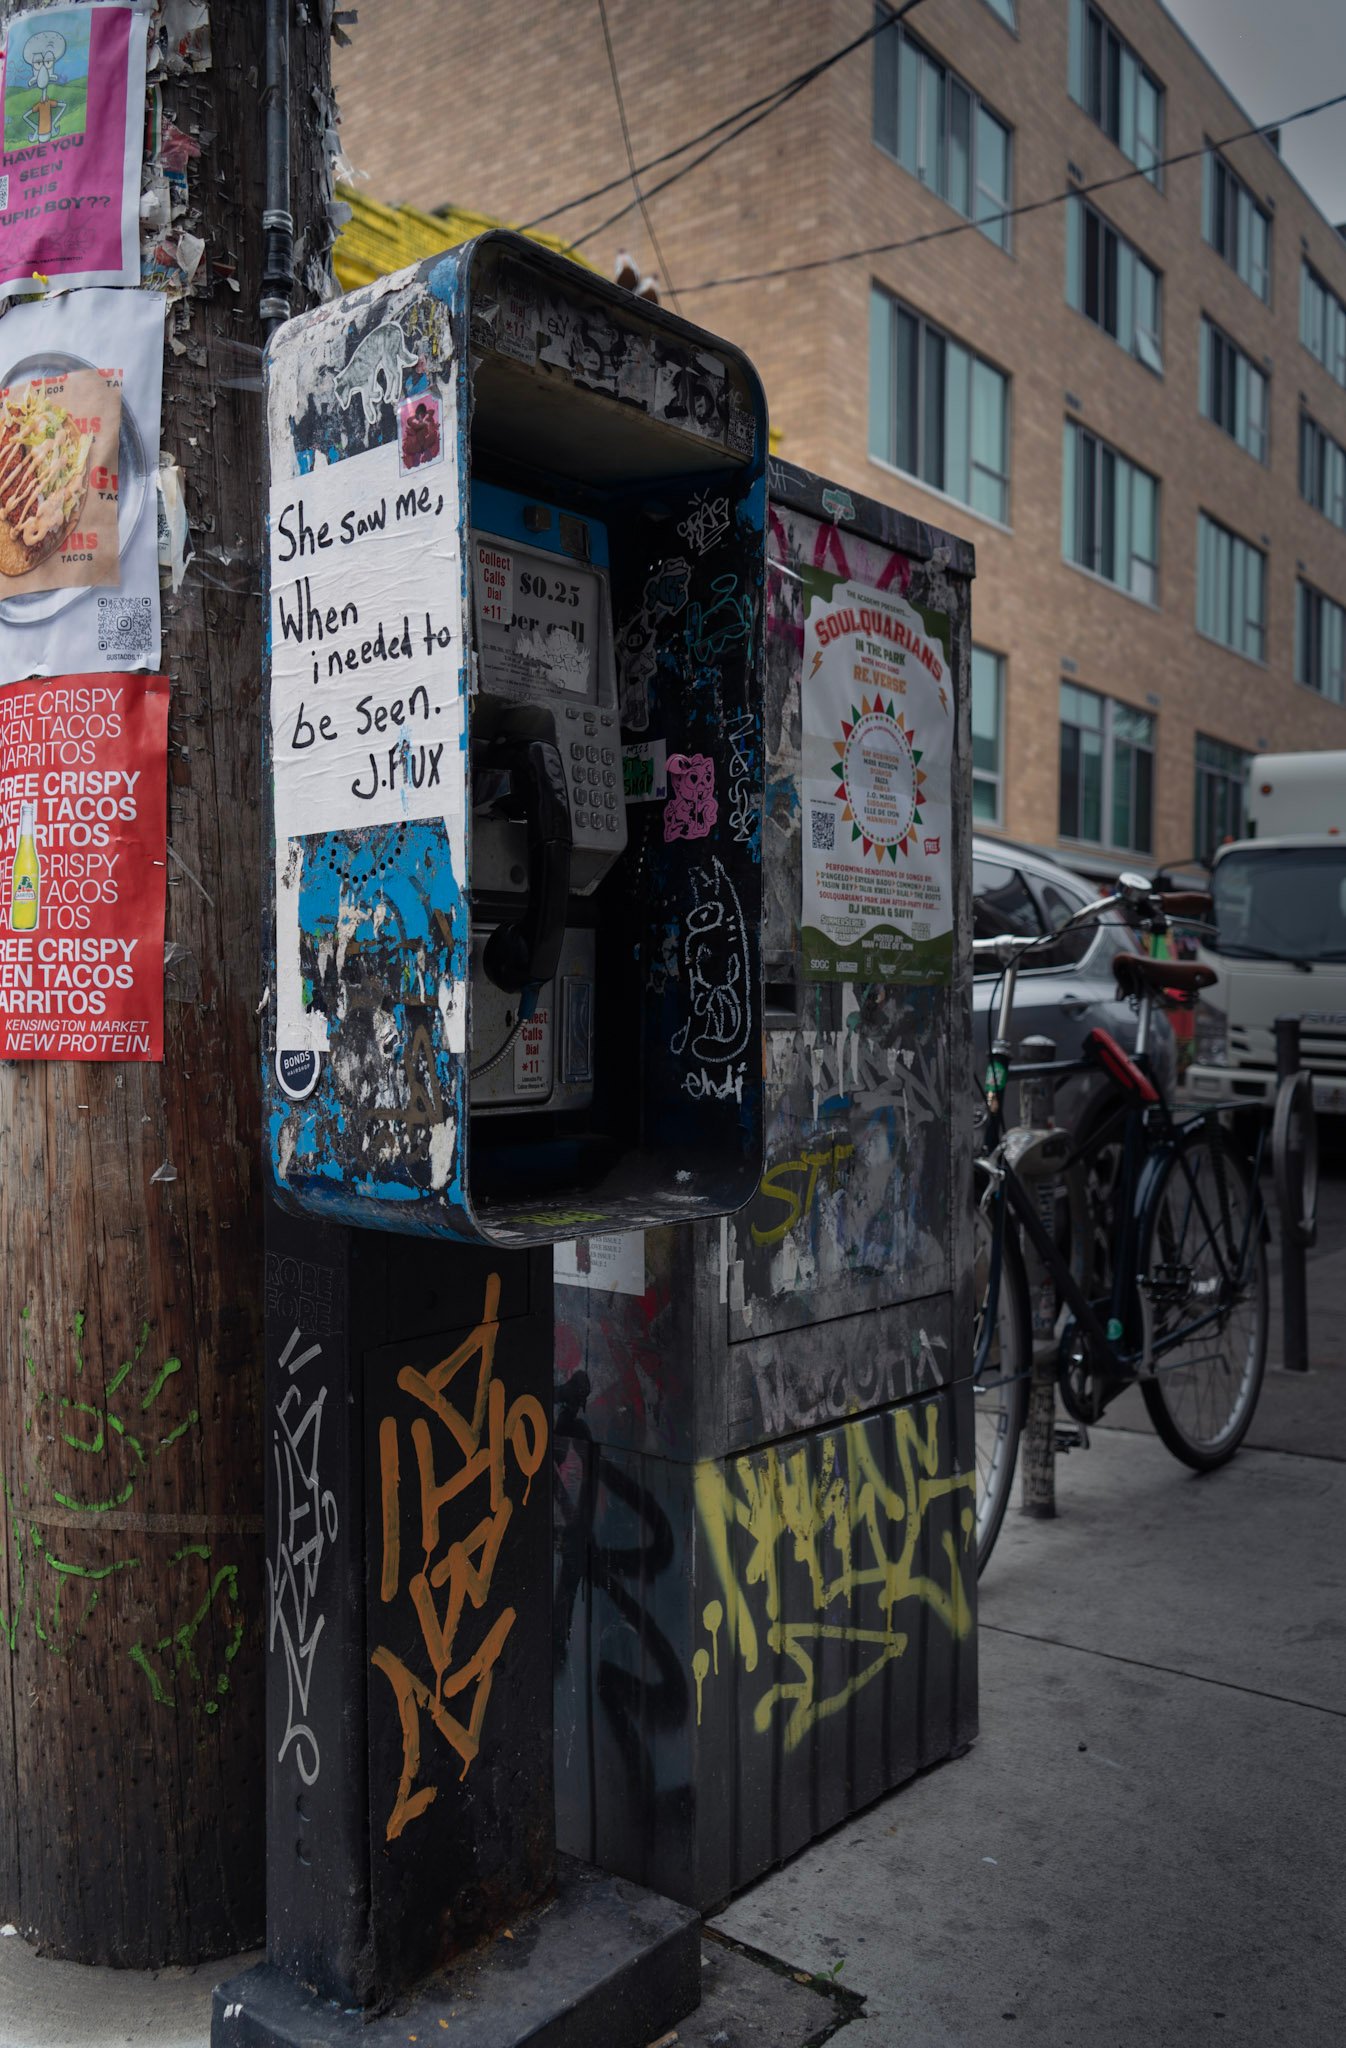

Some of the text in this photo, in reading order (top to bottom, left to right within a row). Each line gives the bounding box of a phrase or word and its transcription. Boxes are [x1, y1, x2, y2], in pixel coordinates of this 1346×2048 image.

[2, 136, 84, 167] HAVE YOU
[20, 160, 63, 182] SEEN
[24, 182, 57, 200] THIS
[0, 196, 111, 226] UPID BOY??
[279, 500, 333, 562] She
[61, 553, 93, 564] TACOS
[479, 549, 512, 571] Collect
[483, 568, 506, 587] Calls
[519, 572, 581, 607] $0.25
[487, 586, 502, 600] Dial
[279, 576, 358, 644] When
[328, 613, 413, 677] needed
[424, 612, 452, 657] to
[814, 607, 943, 682] SOULQUARIANS
[855, 638, 907, 667] IN THE PARK
[38, 688, 124, 715] CRISPY
[37, 713, 122, 740] TACOS
[291, 702, 338, 749] be
[43, 770, 140, 797] CRISPY
[42, 796, 137, 822] TACOS
[848, 903, 860, 914] DJ
[38, 938, 138, 963] CRISPY
[38, 964, 135, 989] TACOS
[5, 1019, 149, 1033] KENSINGTON MARKET
[522, 1027, 543, 1041] Calls
[5, 1033, 56, 1051] NEW
[526, 1044, 539, 1056] Dial
[284, 1051, 310, 1070] BONDS
[287, 1063, 310, 1076] HAIRSHOP
